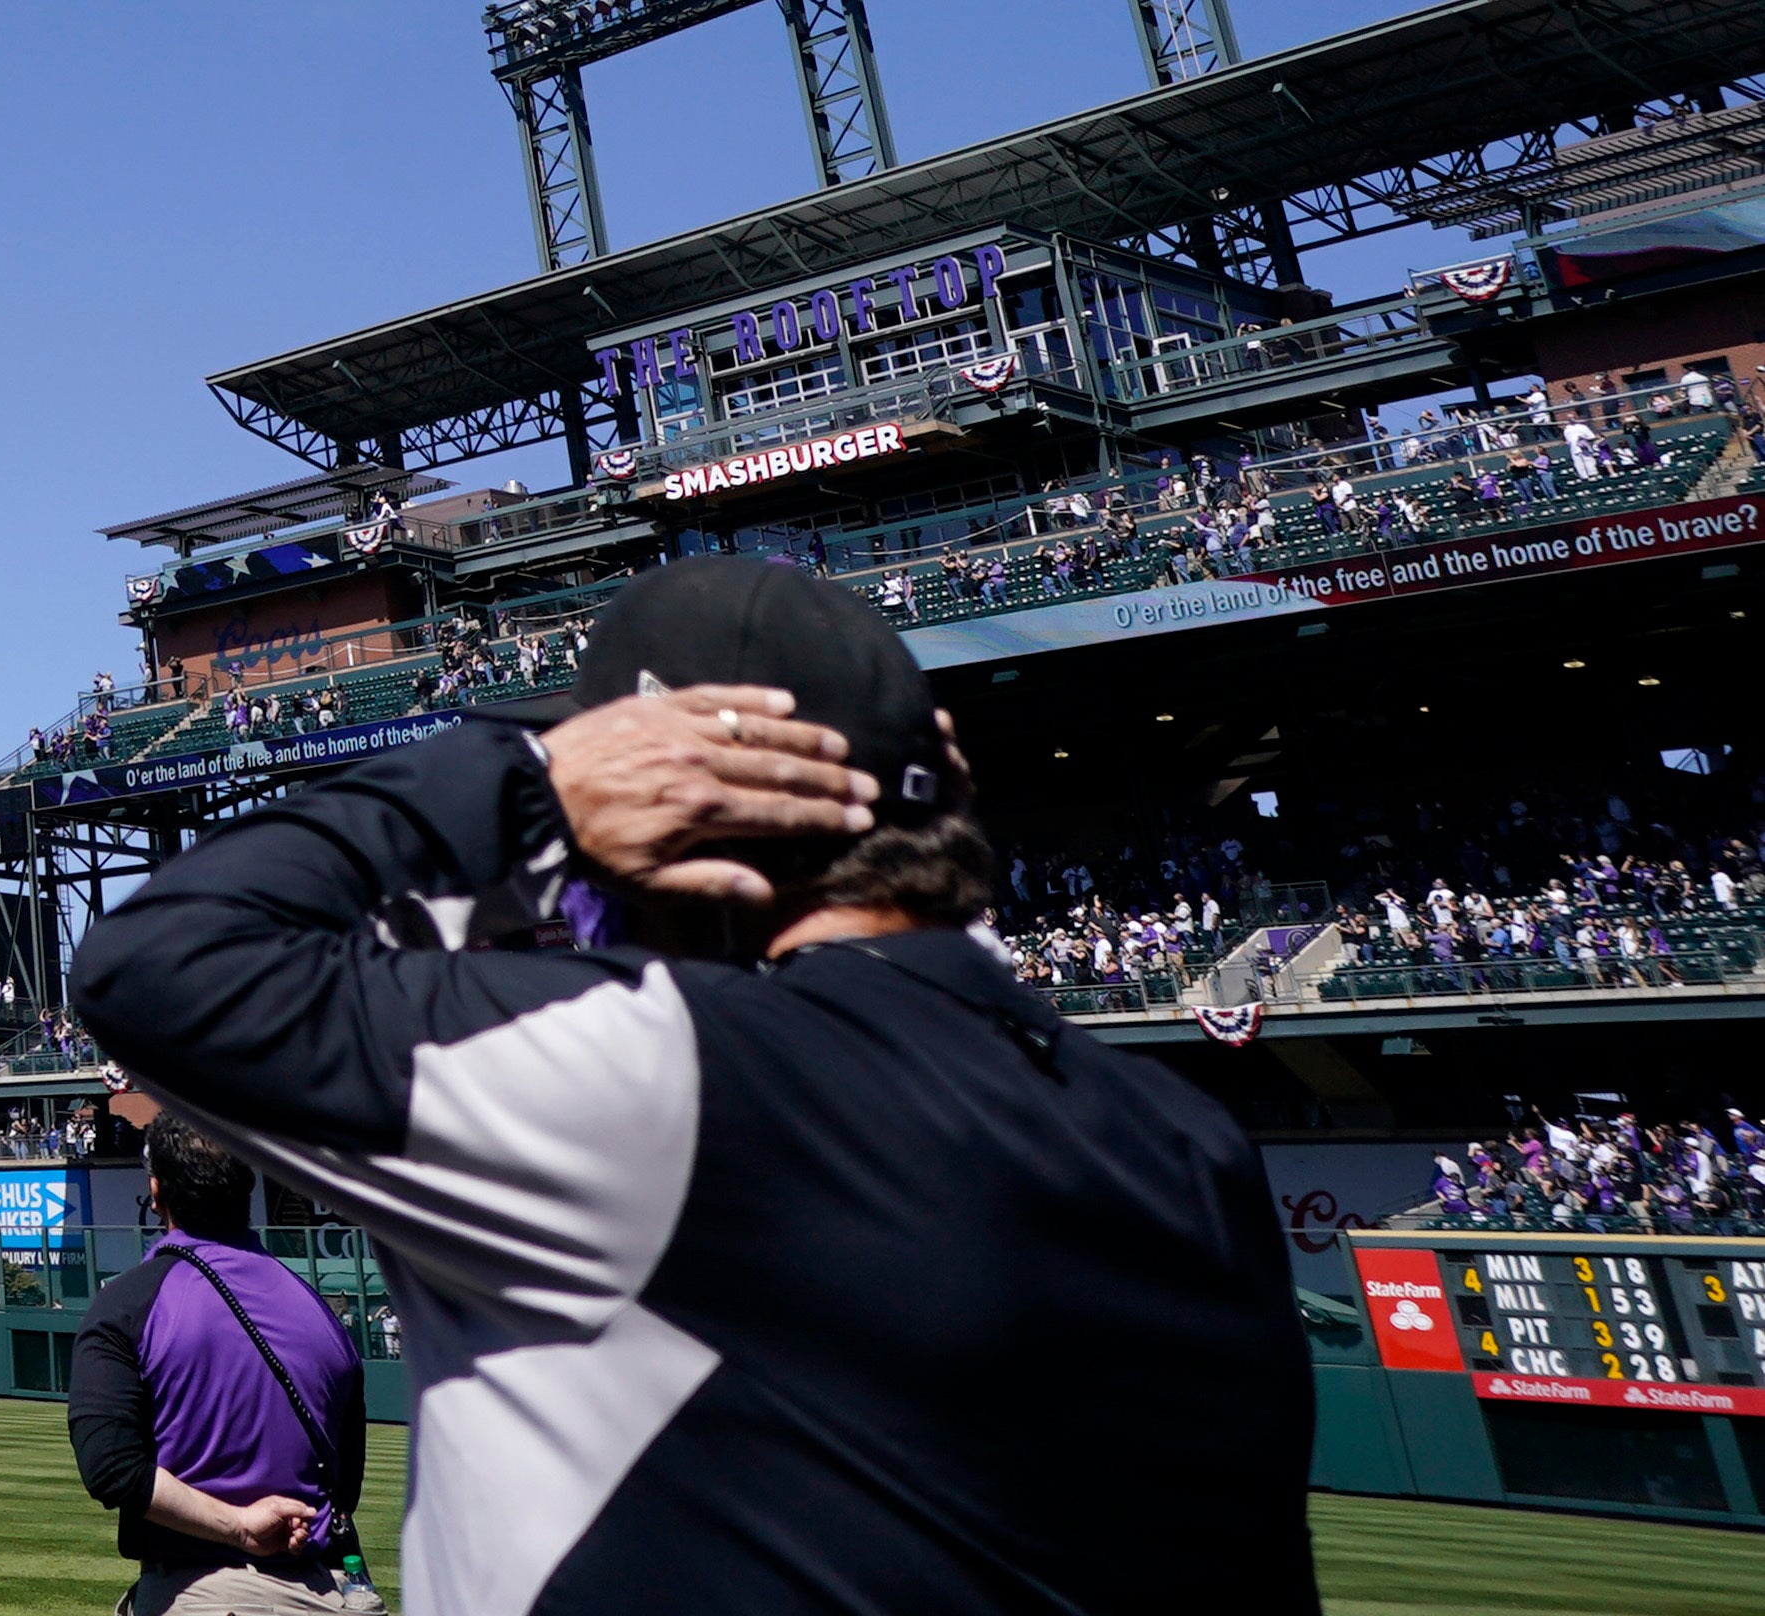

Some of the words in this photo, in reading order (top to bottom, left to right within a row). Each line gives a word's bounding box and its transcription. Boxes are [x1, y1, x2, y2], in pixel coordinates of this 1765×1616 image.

[595, 327, 699, 398] THE
[731, 245, 1007, 363] ROOFTOP
[663, 423, 904, 502] SMASHBURGER
[1114, 603, 1164, 628] O'er
[1170, 598, 1206, 619] the
[1210, 585, 1262, 613] land
[1268, 580, 1290, 604] of
[1291, 575, 1333, 599] the
[1334, 567, 1386, 592] free
[1392, 553, 1441, 584] and
[1443, 549, 1489, 576] the
[1491, 538, 1571, 569] home
[1575, 526, 1603, 556] of
[1605, 523, 1656, 552] the
[1658, 503, 1759, 543] brave?
[125, 768, 154, 789] O'er
[155, 762, 176, 783] the
[177, 756, 206, 780] land
[209, 754, 222, 775] of
[223, 751, 245, 772] the
[247, 747, 273, 768] free
[275, 742, 301, 764] and
[303, 739, 326, 760] the
[327, 734, 367, 756] home
[370, 728, 385, 749] of
[385, 723, 411, 745] the
[1464, 1268, 1484, 1294] 4
[1485, 1254, 1543, 1282] MIN
[1573, 1256, 1595, 1284] 3
[1703, 1275, 1727, 1303] 3
[1493, 1284, 1549, 1313] MIL
[1583, 1287, 1601, 1313] 1
[1480, 1331, 1499, 1357] 4
[1506, 1317, 1551, 1347] PIT
[1593, 1320, 1615, 1349] 3
[1510, 1347, 1570, 1377] CHC
[1601, 1352, 1624, 1380] 2
